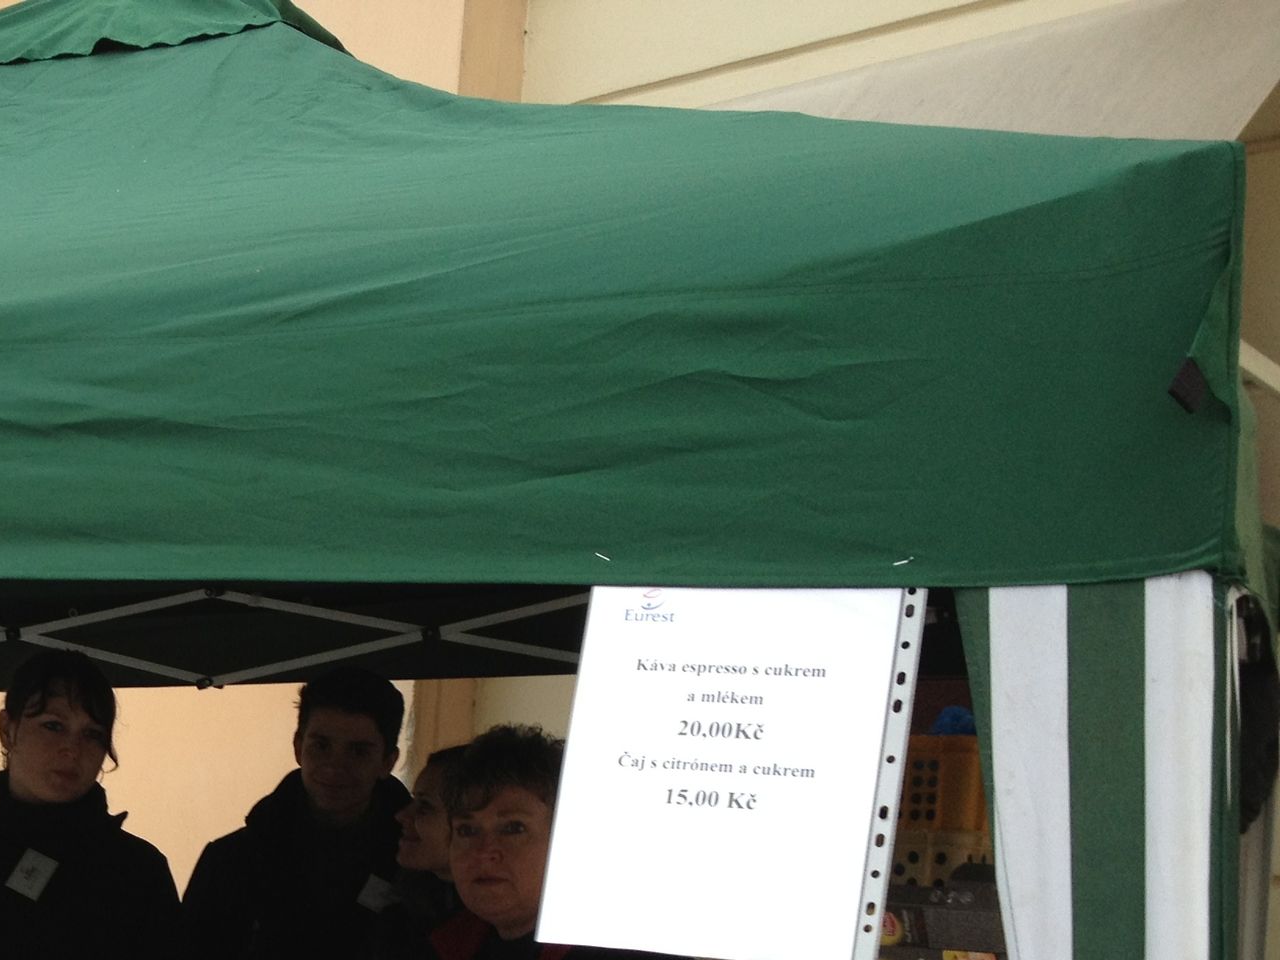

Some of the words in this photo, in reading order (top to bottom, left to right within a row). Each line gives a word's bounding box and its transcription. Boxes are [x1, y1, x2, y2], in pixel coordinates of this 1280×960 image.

[625, 609, 675, 623] Eurest
[636, 658, 677, 673] Káva
[681, 662, 748, 677] espresso
[752, 665, 759, 675] s
[764, 664, 827, 679] cukrem
[687, 692, 695, 702] a
[701, 690, 764, 706] mlékem
[618, 751, 647, 771] Čaj
[650, 758, 657, 768] s
[662, 757, 734, 773] citrónem
[739, 764, 747, 774] a
[752, 763, 816, 779] cukrem
[727, 791, 757, 810] Kč
